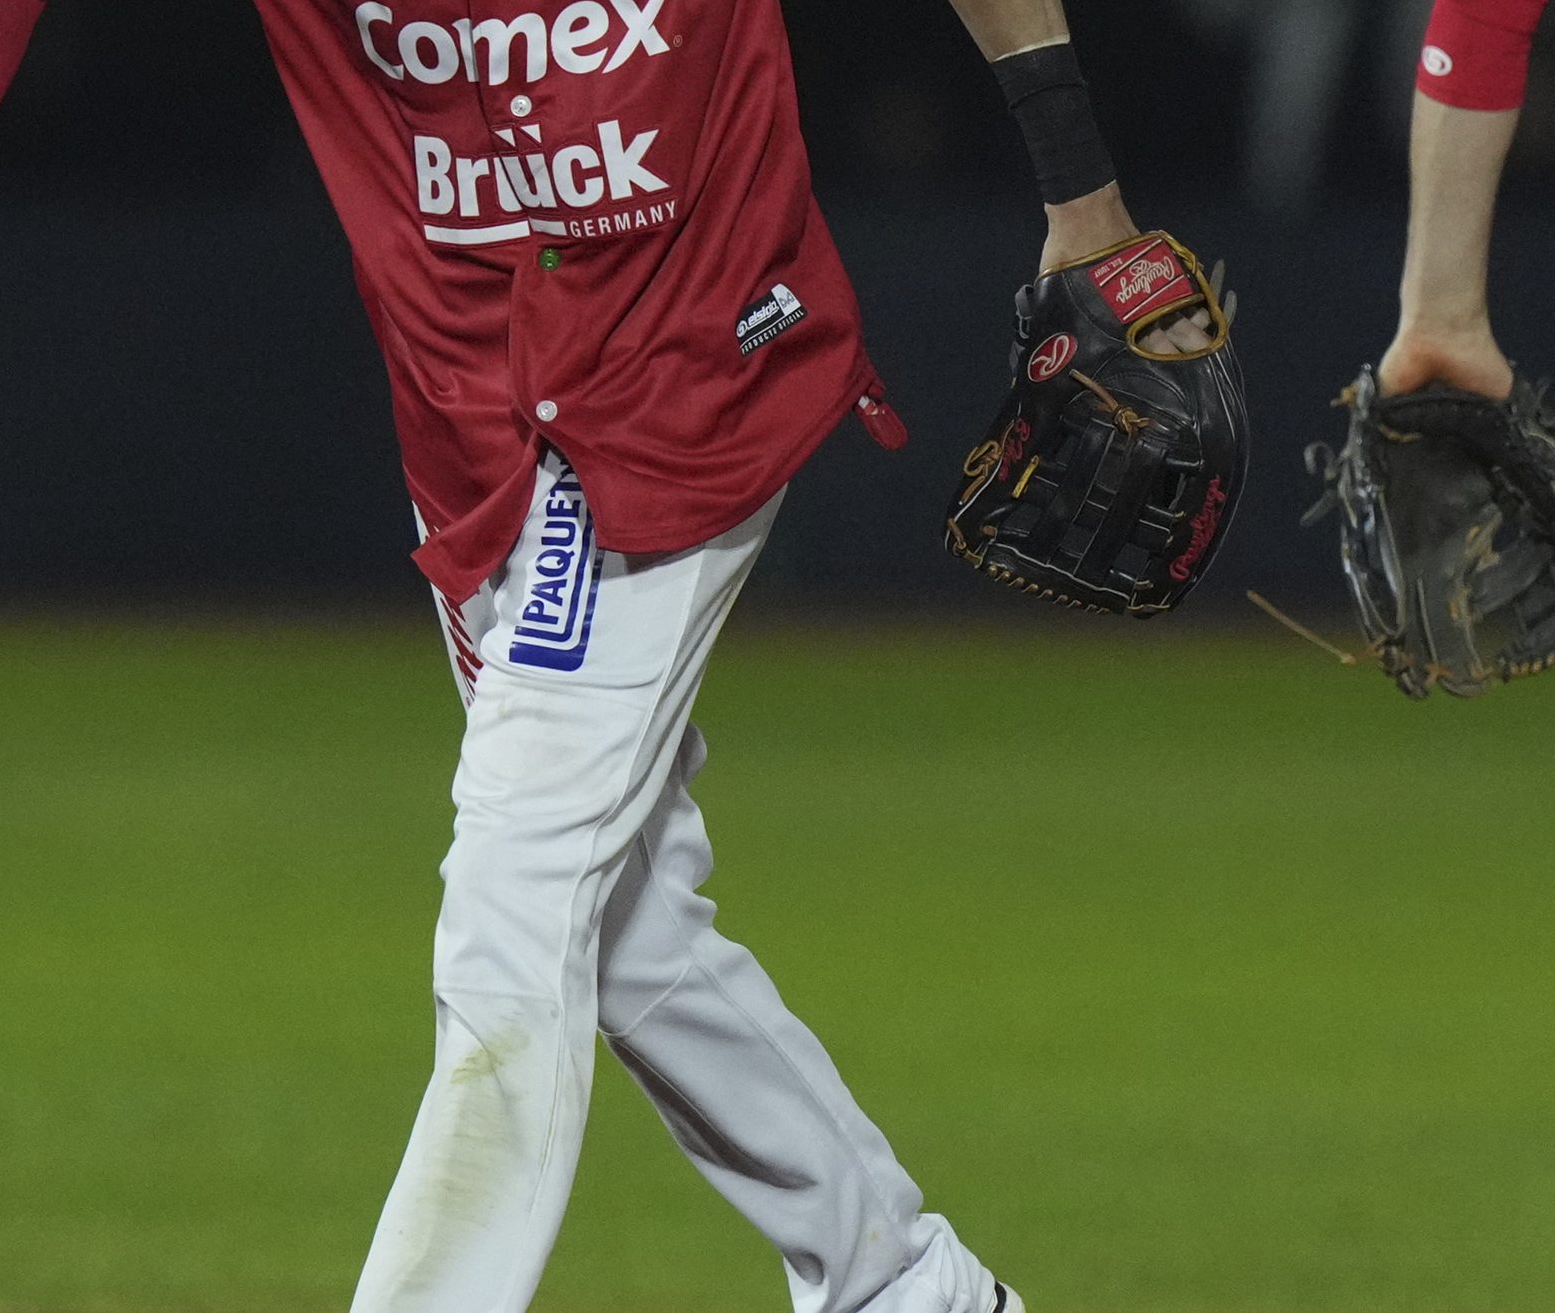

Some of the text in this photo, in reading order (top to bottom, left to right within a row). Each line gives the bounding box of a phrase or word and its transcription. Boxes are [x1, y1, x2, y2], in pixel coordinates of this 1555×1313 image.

[413, 120, 671, 219] Brück
[568, 199, 679, 239] GERMANY
[1115, 256, 1175, 303] Rawlings
